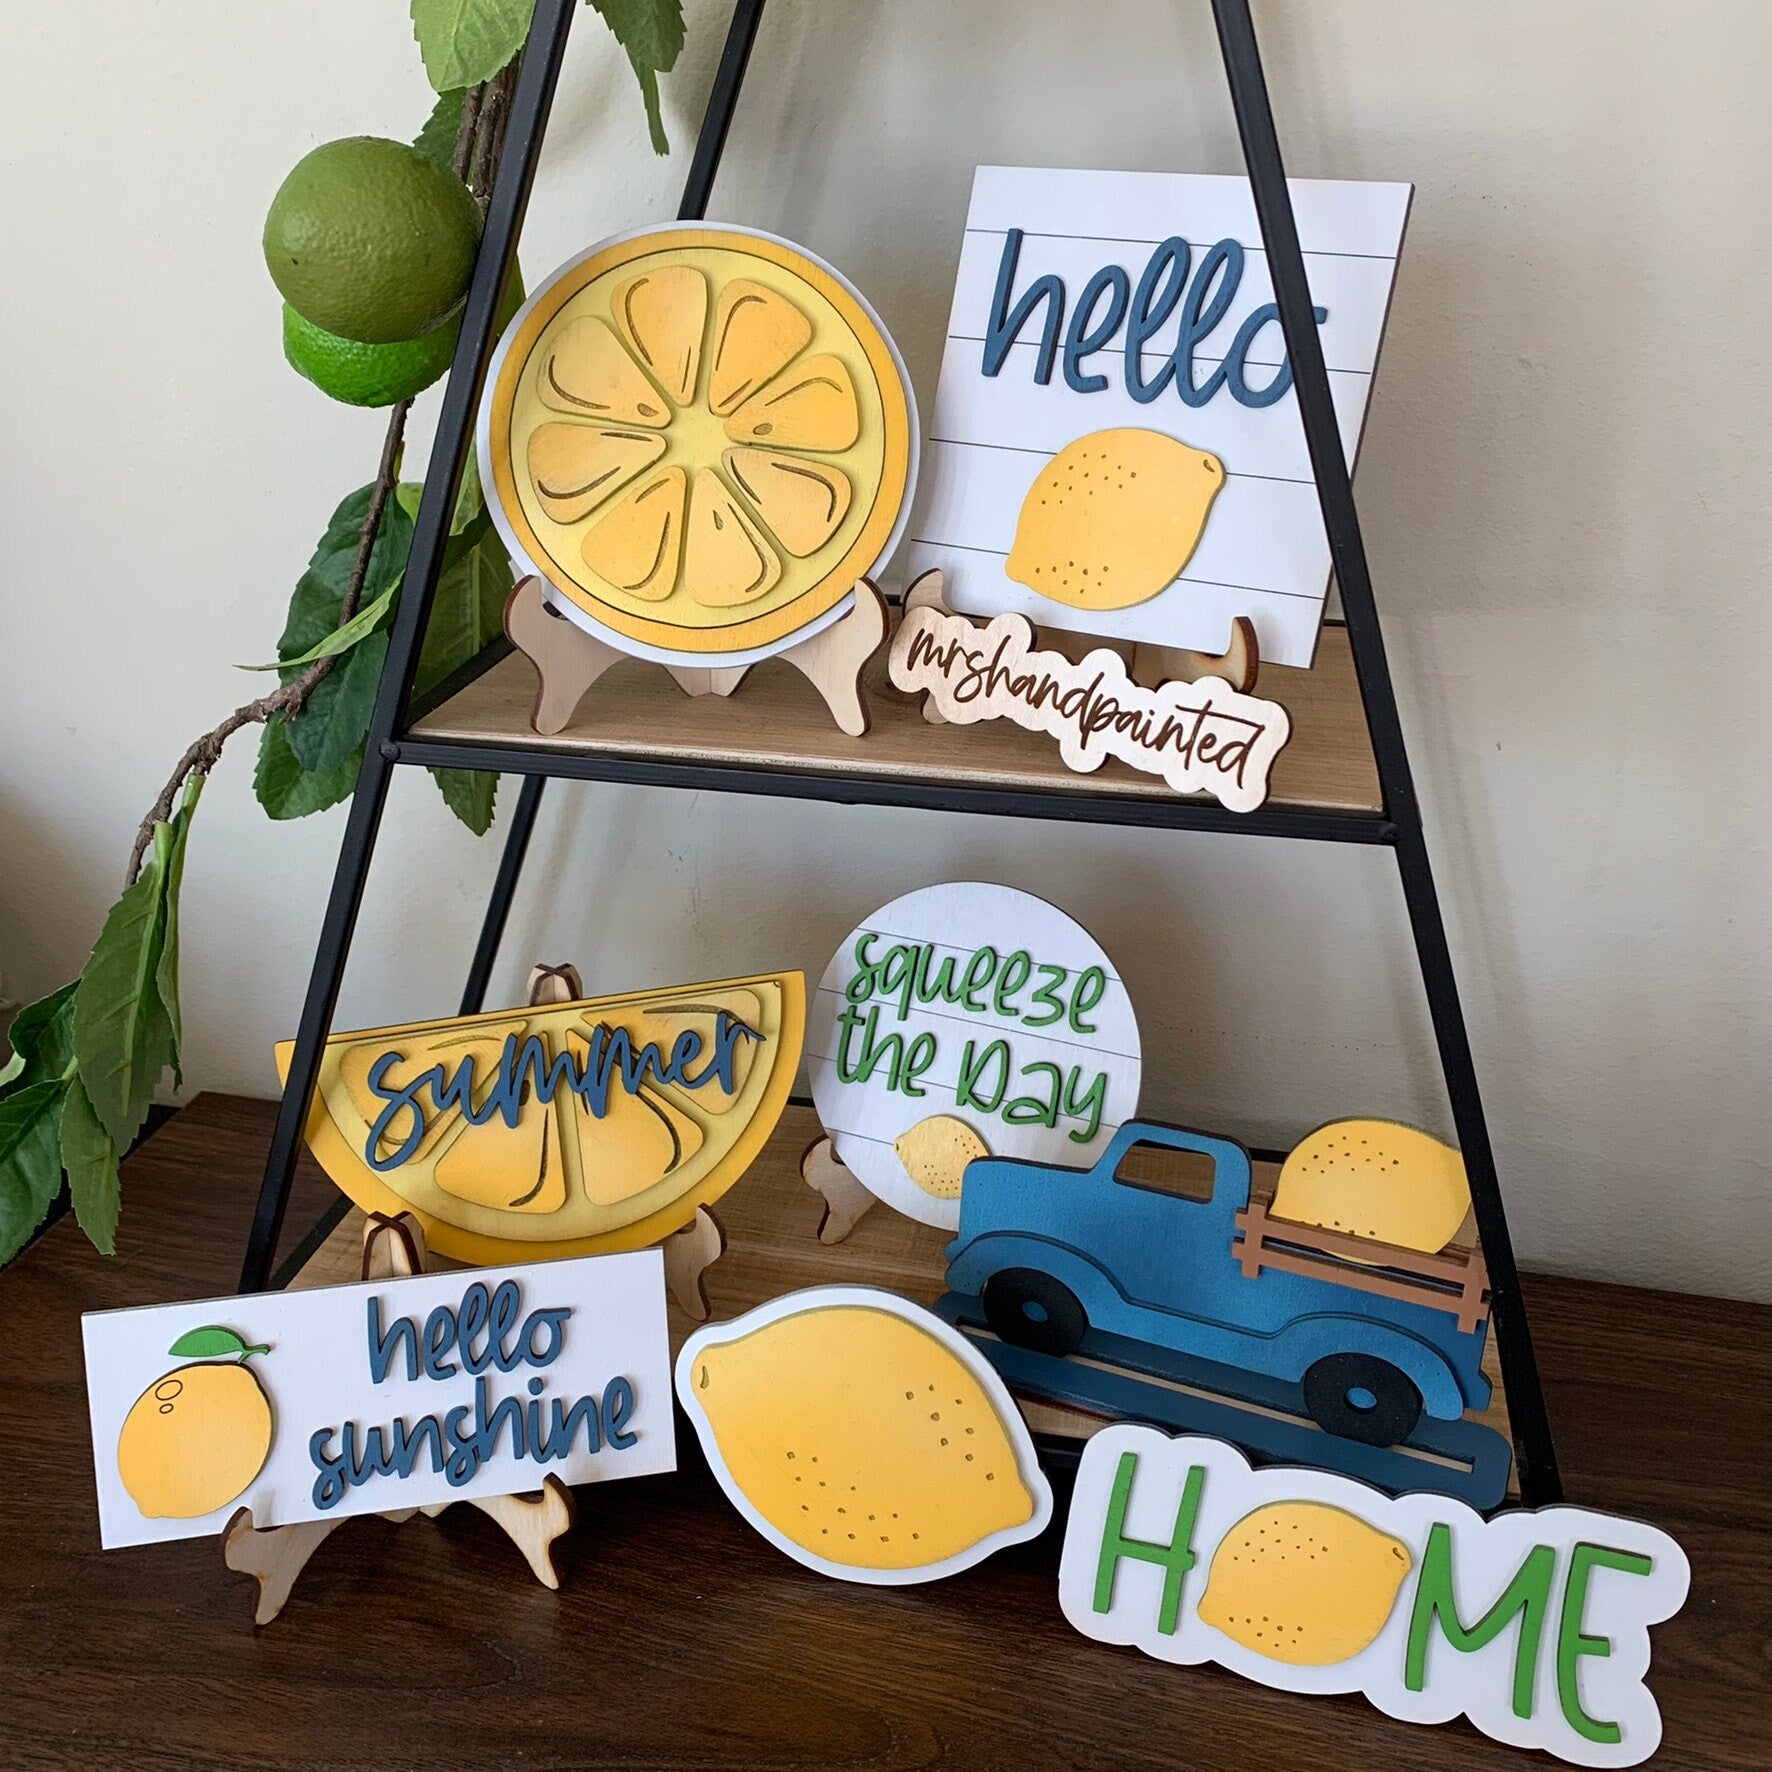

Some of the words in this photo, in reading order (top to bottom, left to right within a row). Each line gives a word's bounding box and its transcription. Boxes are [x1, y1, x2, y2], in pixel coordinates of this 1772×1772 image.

[982, 228, 1328, 408] hello
[907, 628, 1265, 789] mrshandpainted
[837, 1004, 937, 1097] the
[845, 933, 1105, 1033] squeeze
[365, 1011, 765, 1171] summer
[367, 1279, 574, 1384] hello
[309, 1375, 638, 1510] sunshine
